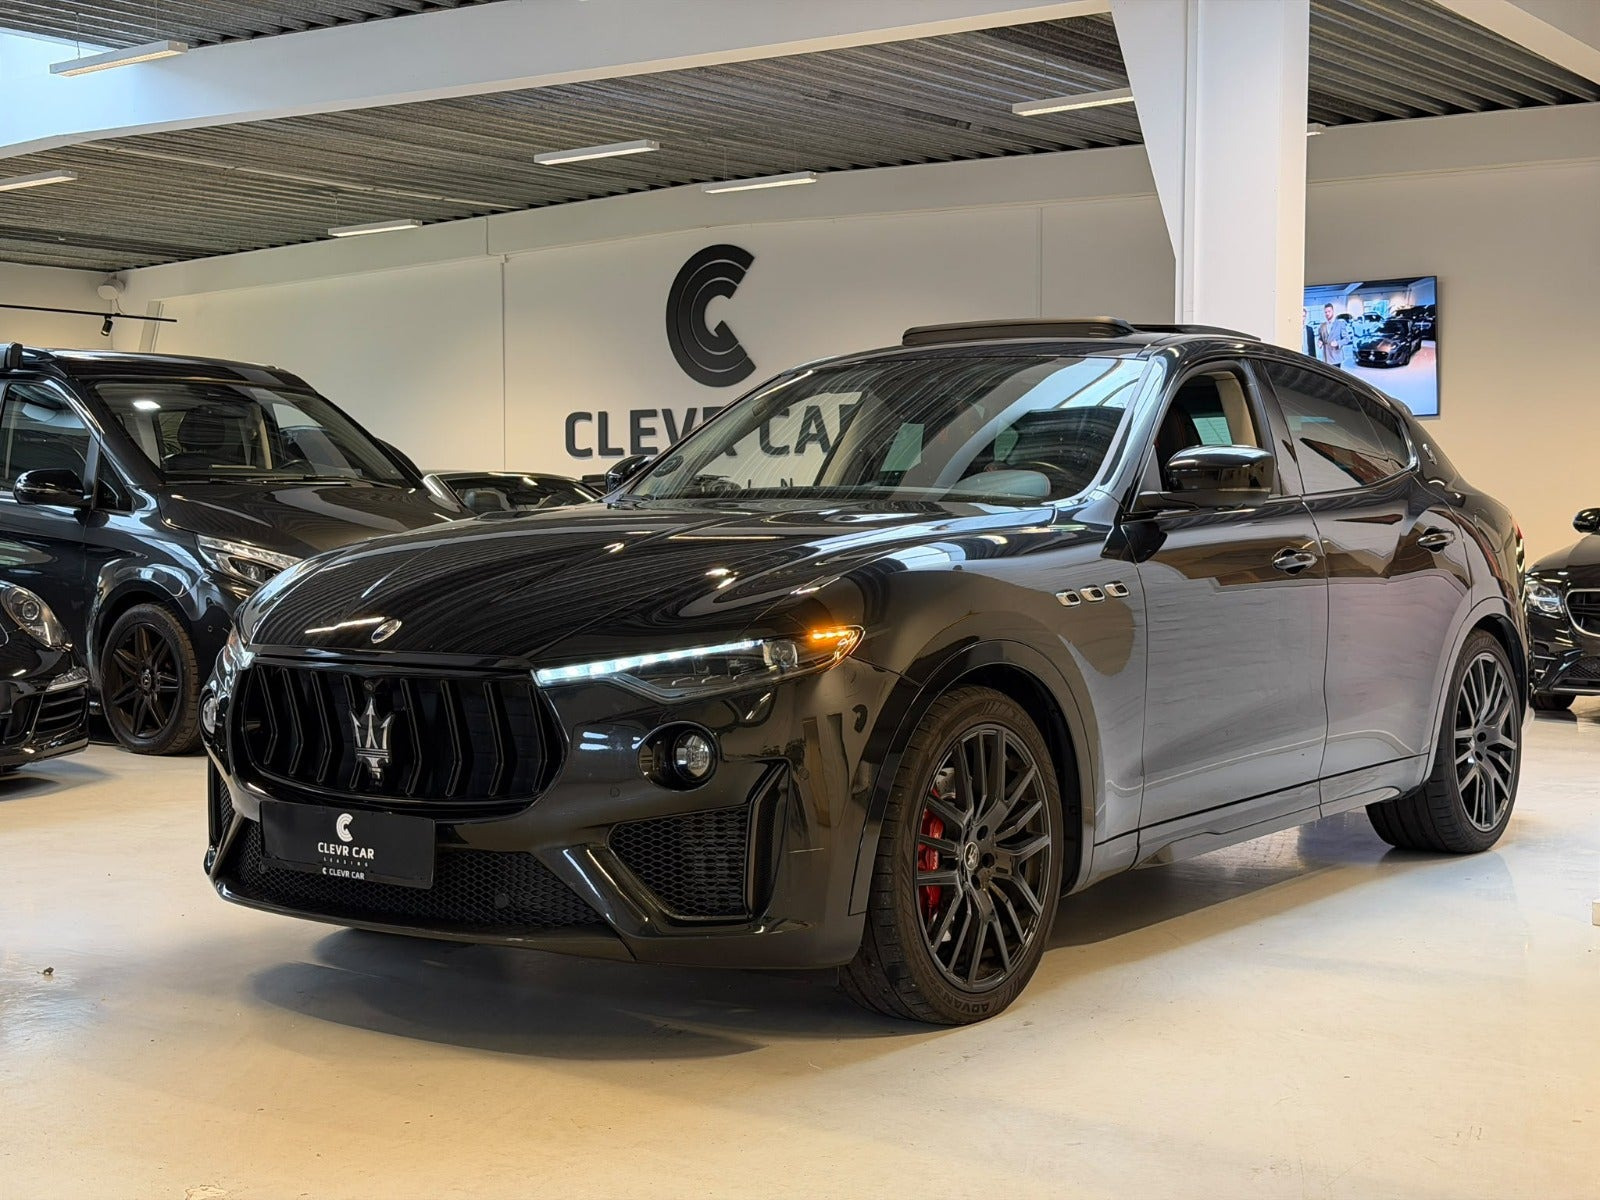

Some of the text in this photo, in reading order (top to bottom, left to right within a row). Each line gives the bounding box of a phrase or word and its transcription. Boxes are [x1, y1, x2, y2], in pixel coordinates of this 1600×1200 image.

[317, 842, 374, 859] CLEVR CAR
[329, 868, 350, 878] CLEVR
[351, 871, 364, 880] CAR
